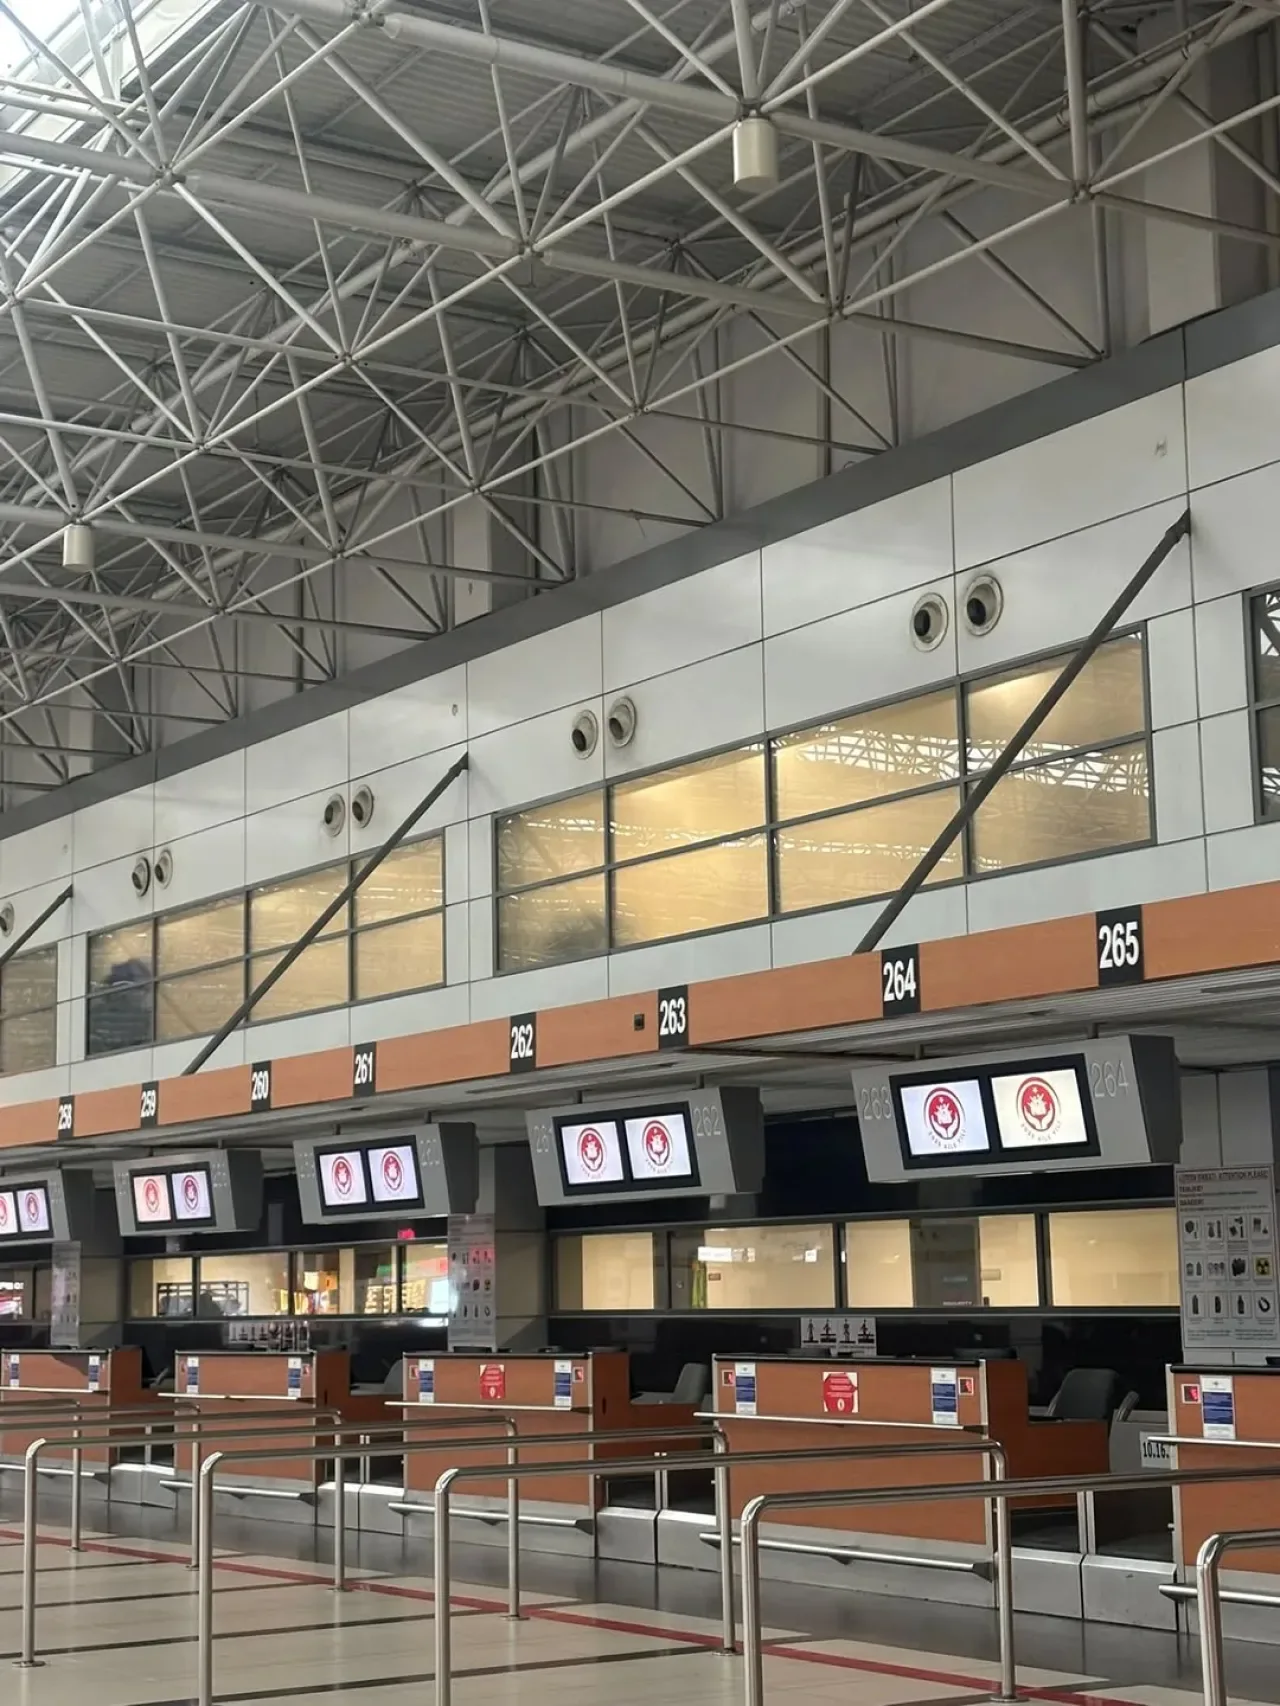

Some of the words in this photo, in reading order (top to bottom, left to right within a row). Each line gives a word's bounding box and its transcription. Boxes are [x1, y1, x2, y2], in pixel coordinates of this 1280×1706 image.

[1099, 921, 1139, 968] 265
[883, 958, 916, 1001] 264
[660, 997, 686, 1035] 263
[511, 1023, 533, 1058] 262
[354, 1052, 373, 1084] 261
[1091, 1060, 1129, 1097] 264
[251, 1070, 269, 1100] 260
[58, 1104, 72, 1129] 258
[140, 1090, 156, 1117] 259
[693, 1106, 721, 1136] 262
